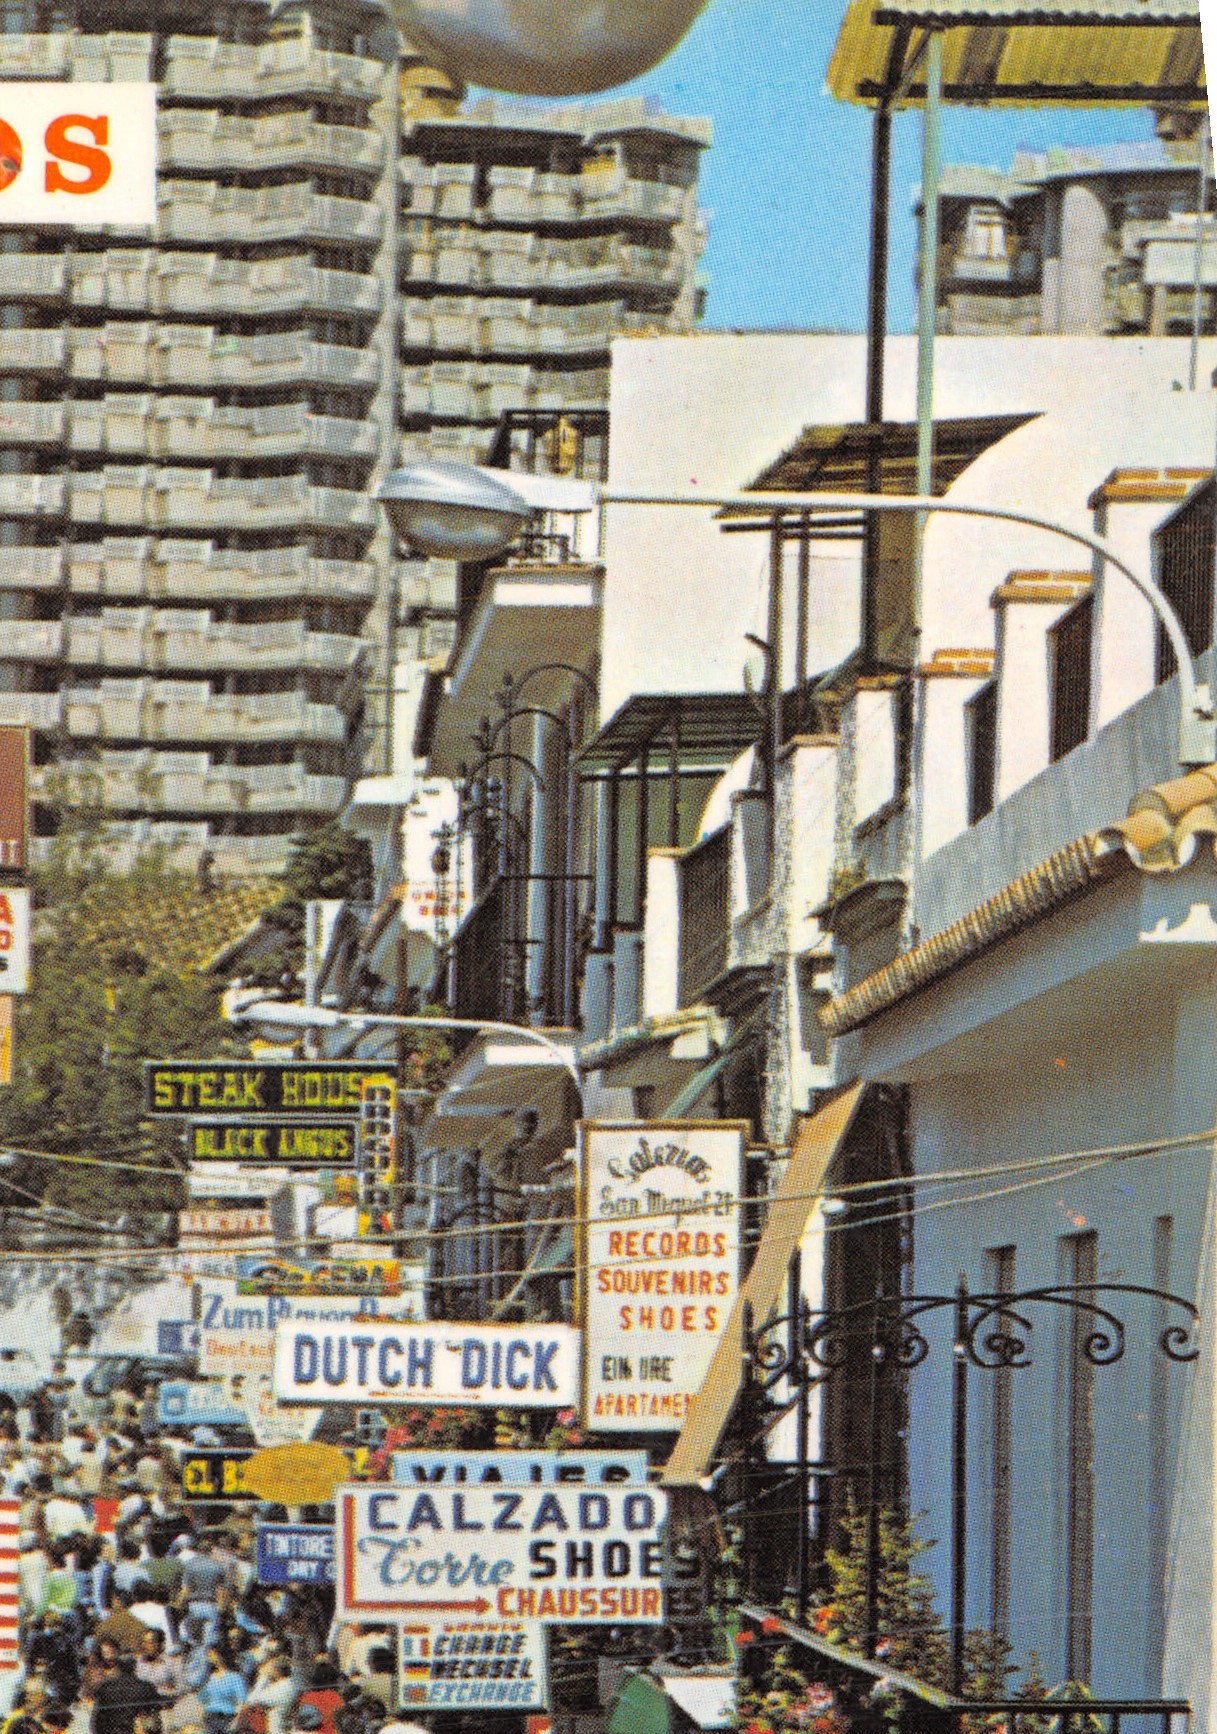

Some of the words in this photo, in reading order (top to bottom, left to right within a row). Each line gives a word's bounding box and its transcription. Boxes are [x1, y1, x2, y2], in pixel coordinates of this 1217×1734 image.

[153, 1072, 264, 1108] STEAK
[280, 1072, 361, 1108] HOUS
[193, 1128, 270, 1158] BLACK
[276, 1128, 351, 1158] ANGUS
[608, 1231, 727, 1258] RECORDS
[597, 1268, 731, 1297] SOUVENIRS
[204, 1294, 265, 1330] Zum
[619, 1304, 719, 1332] SHOES
[292, 1332, 436, 1390] DUTCH
[461, 1337, 560, 1394] DICK
[357, 1535, 516, 1590] Torre
[434, 1633, 528, 1656] CHANGE
[429, 1656, 533, 1680] WECHSEL
[427, 1680, 536, 1702] EXCHANGE
